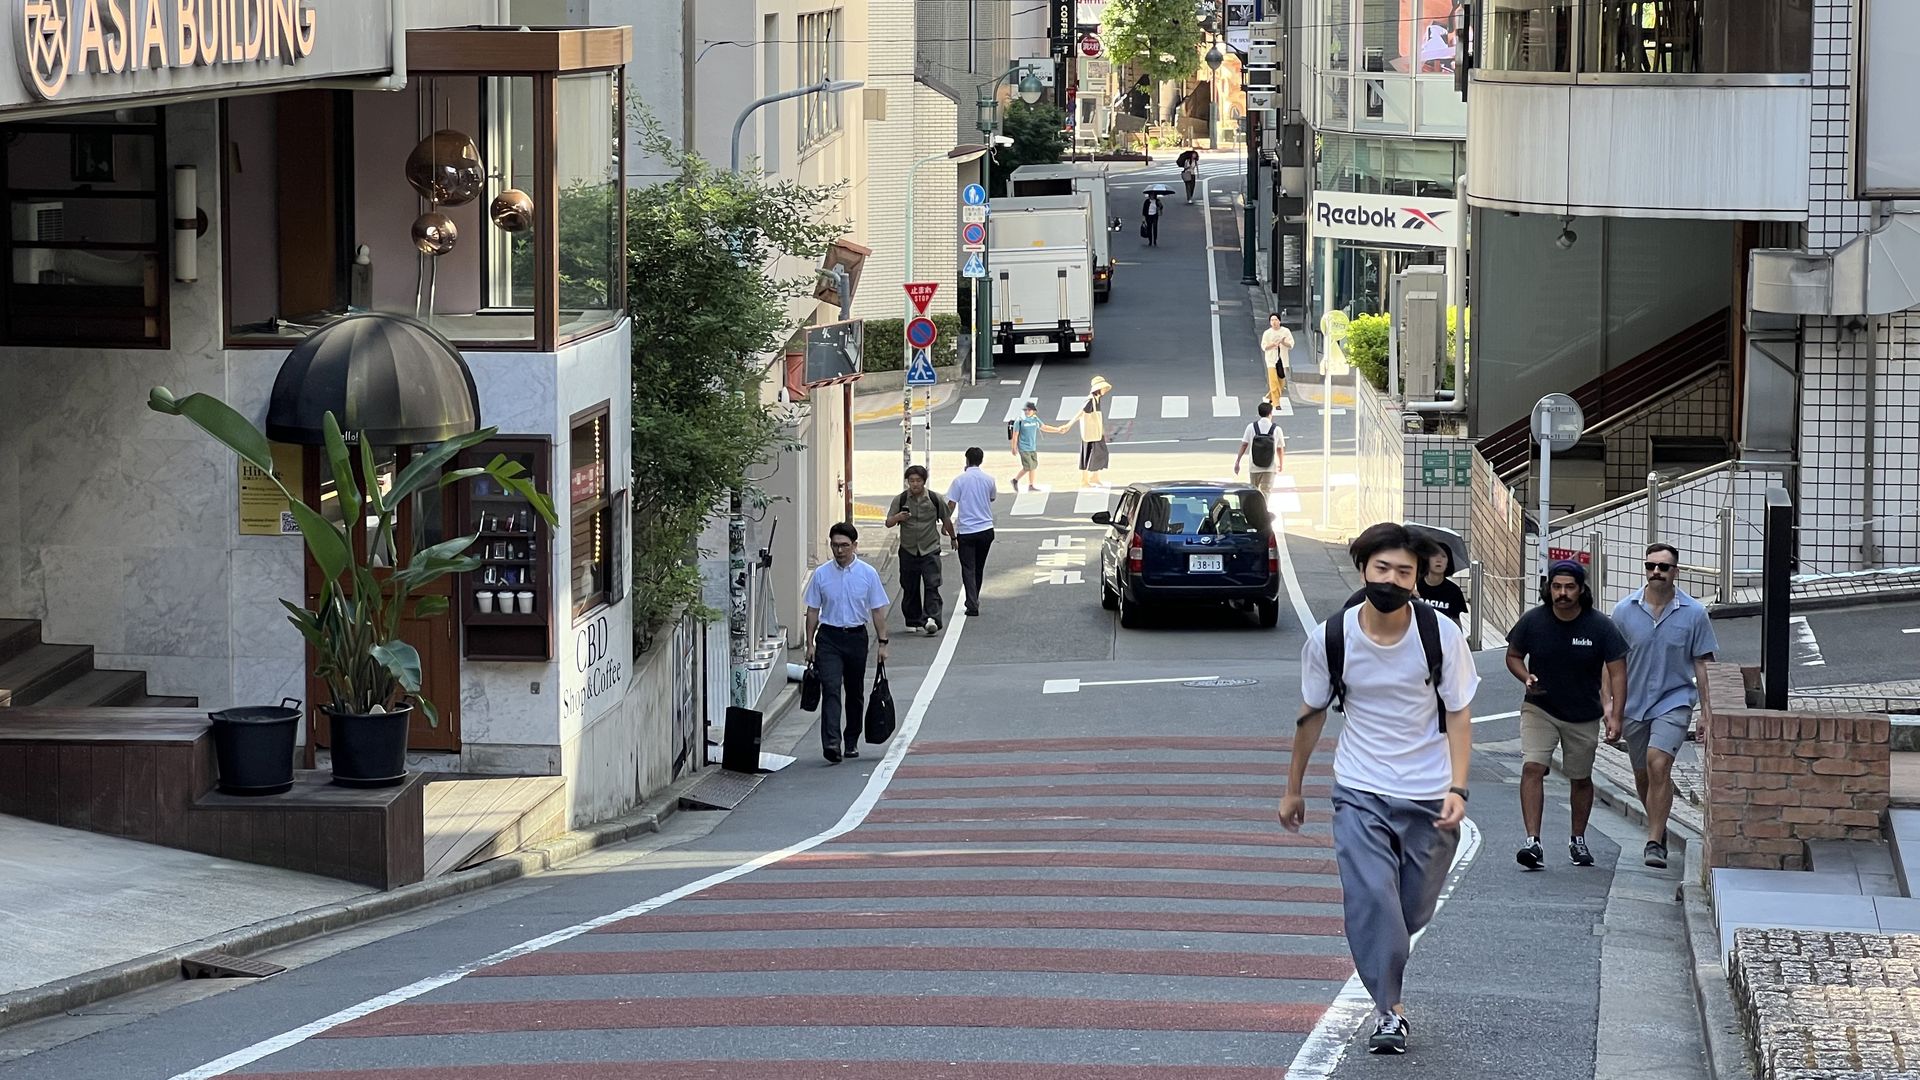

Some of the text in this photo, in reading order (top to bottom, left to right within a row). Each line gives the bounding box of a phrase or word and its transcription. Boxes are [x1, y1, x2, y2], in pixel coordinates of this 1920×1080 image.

[78, 0, 316, 74] ASIA BUILDING
[1317, 202, 1396, 228] Reebok
[911, 286, 932, 295] 止まれ
[914, 294, 930, 302] STOP
[1033, 534, 1086, 585] 止まれ
[1196, 560, 1221, 570] 38-13
[576, 616, 608, 673] CBD
